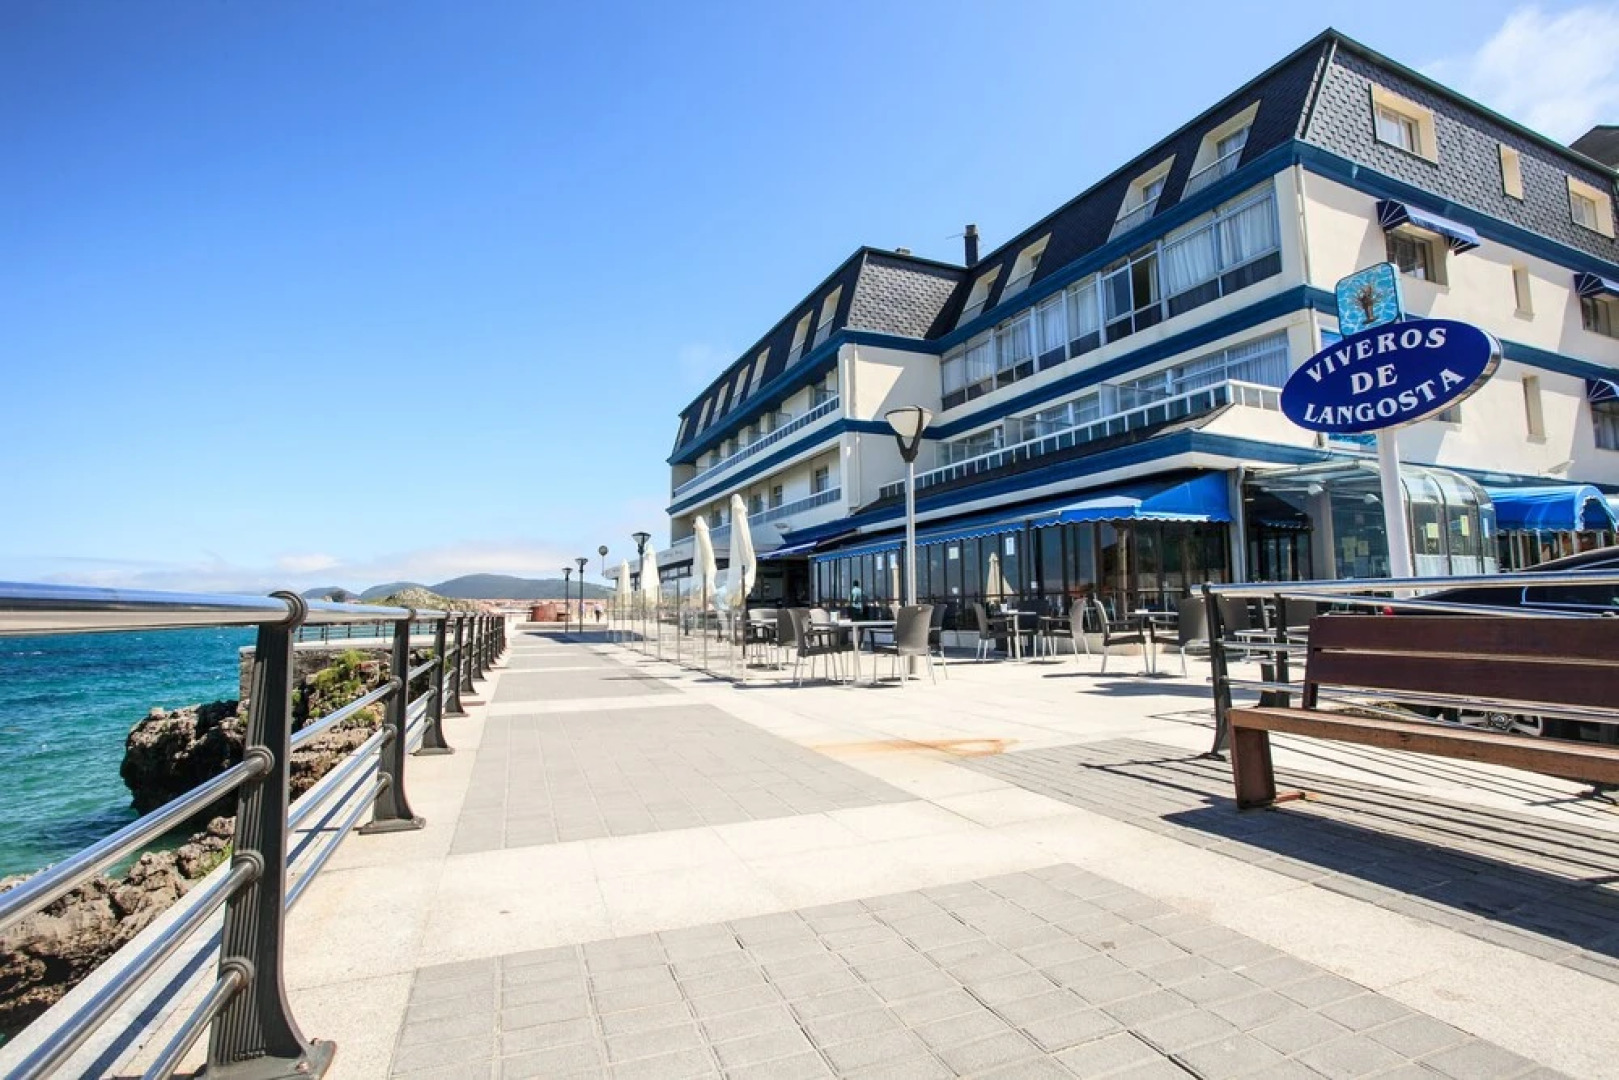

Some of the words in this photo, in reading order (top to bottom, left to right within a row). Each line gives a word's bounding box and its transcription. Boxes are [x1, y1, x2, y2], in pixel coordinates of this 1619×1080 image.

[1306, 327, 1447, 383] VIVEROS
[1350, 363, 1398, 395] DE
[1303, 368, 1465, 425] LANGOSTA
